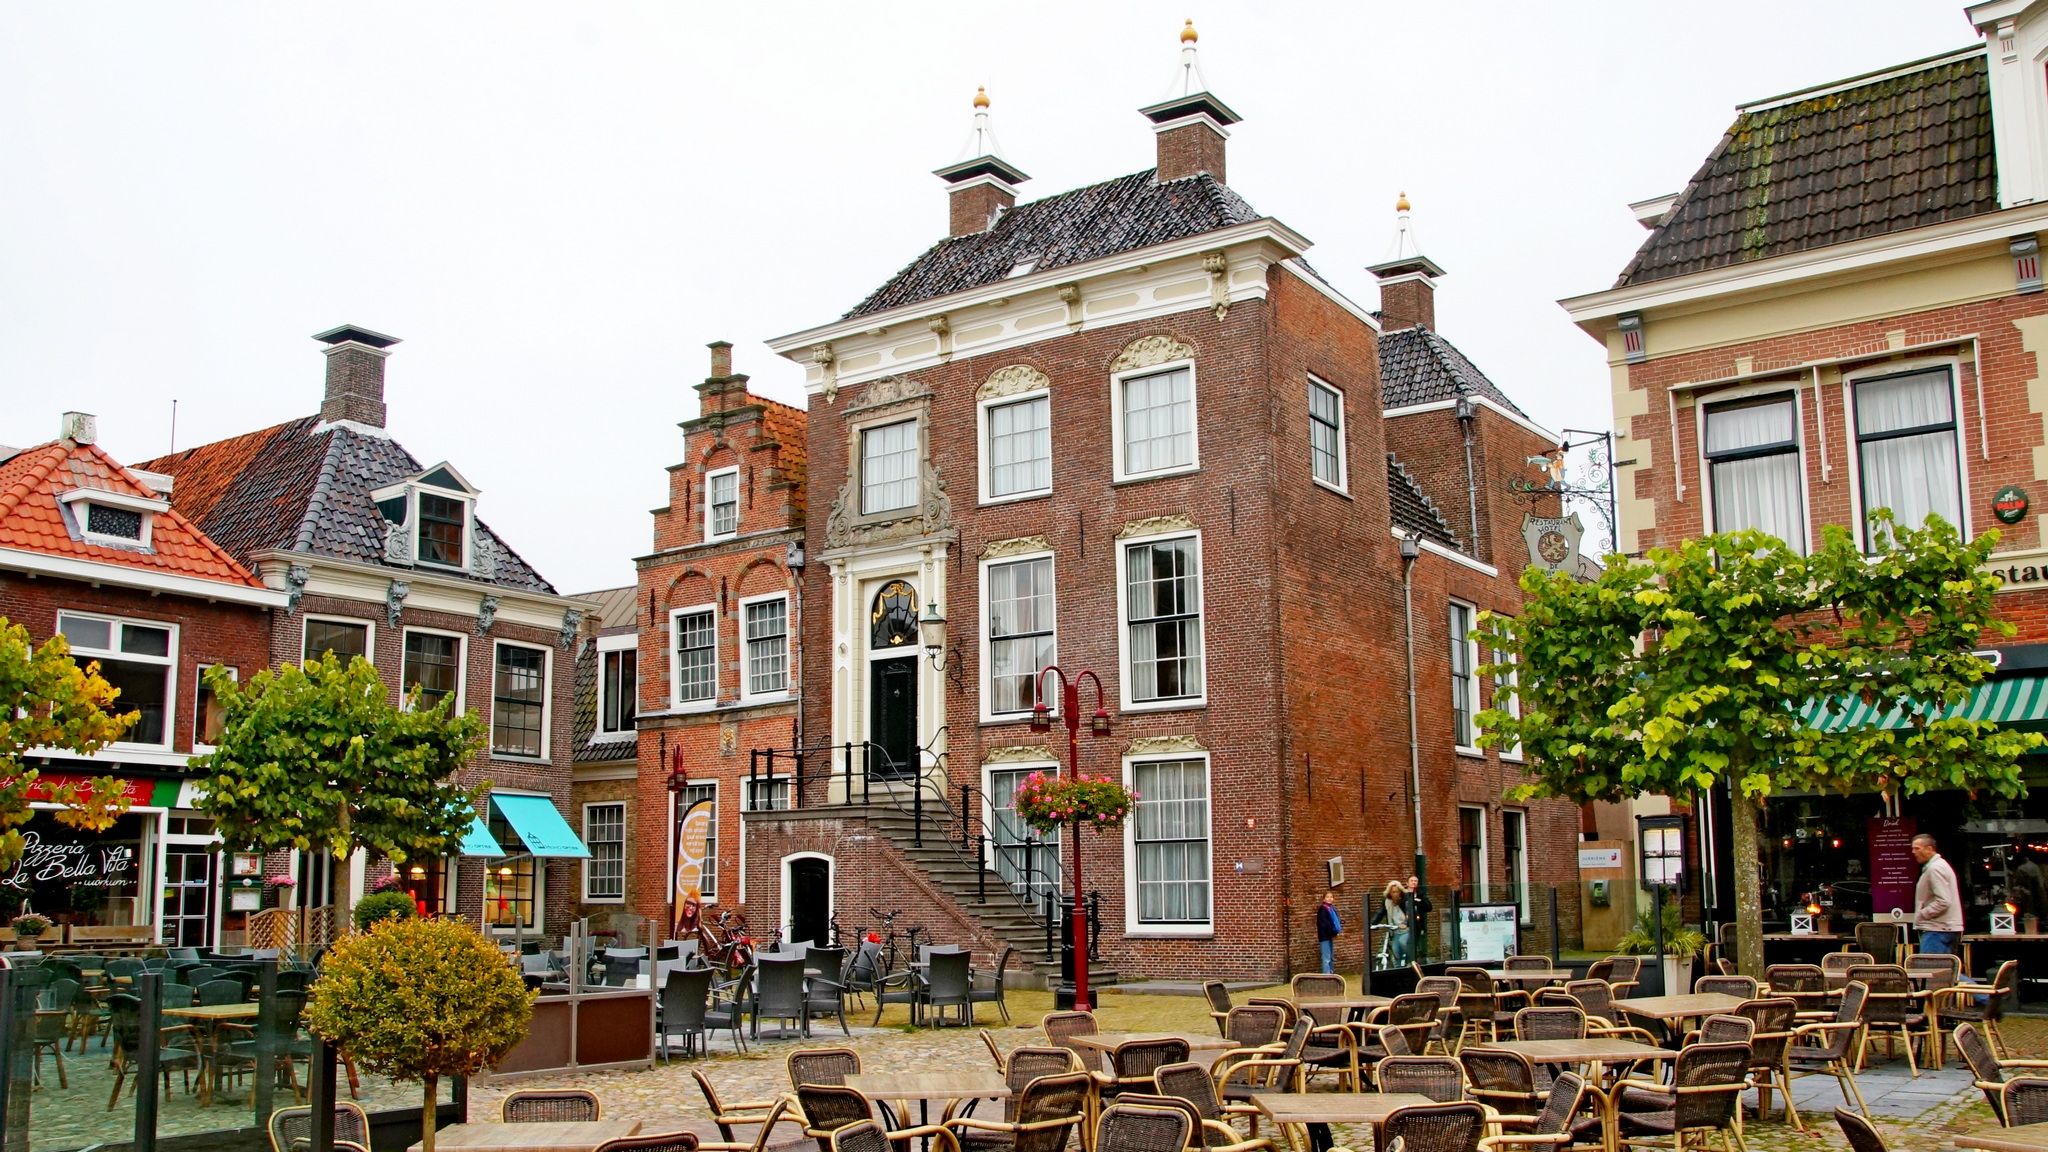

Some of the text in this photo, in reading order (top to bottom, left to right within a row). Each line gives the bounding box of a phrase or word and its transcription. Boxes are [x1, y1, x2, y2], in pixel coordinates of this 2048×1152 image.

[1529, 517, 1572, 527] RESTAURANT
[1538, 524, 1561, 535] HOTEL
[21, 831, 86, 867] Pizzeria
[2, 845, 133, 891] La Bella Vita
